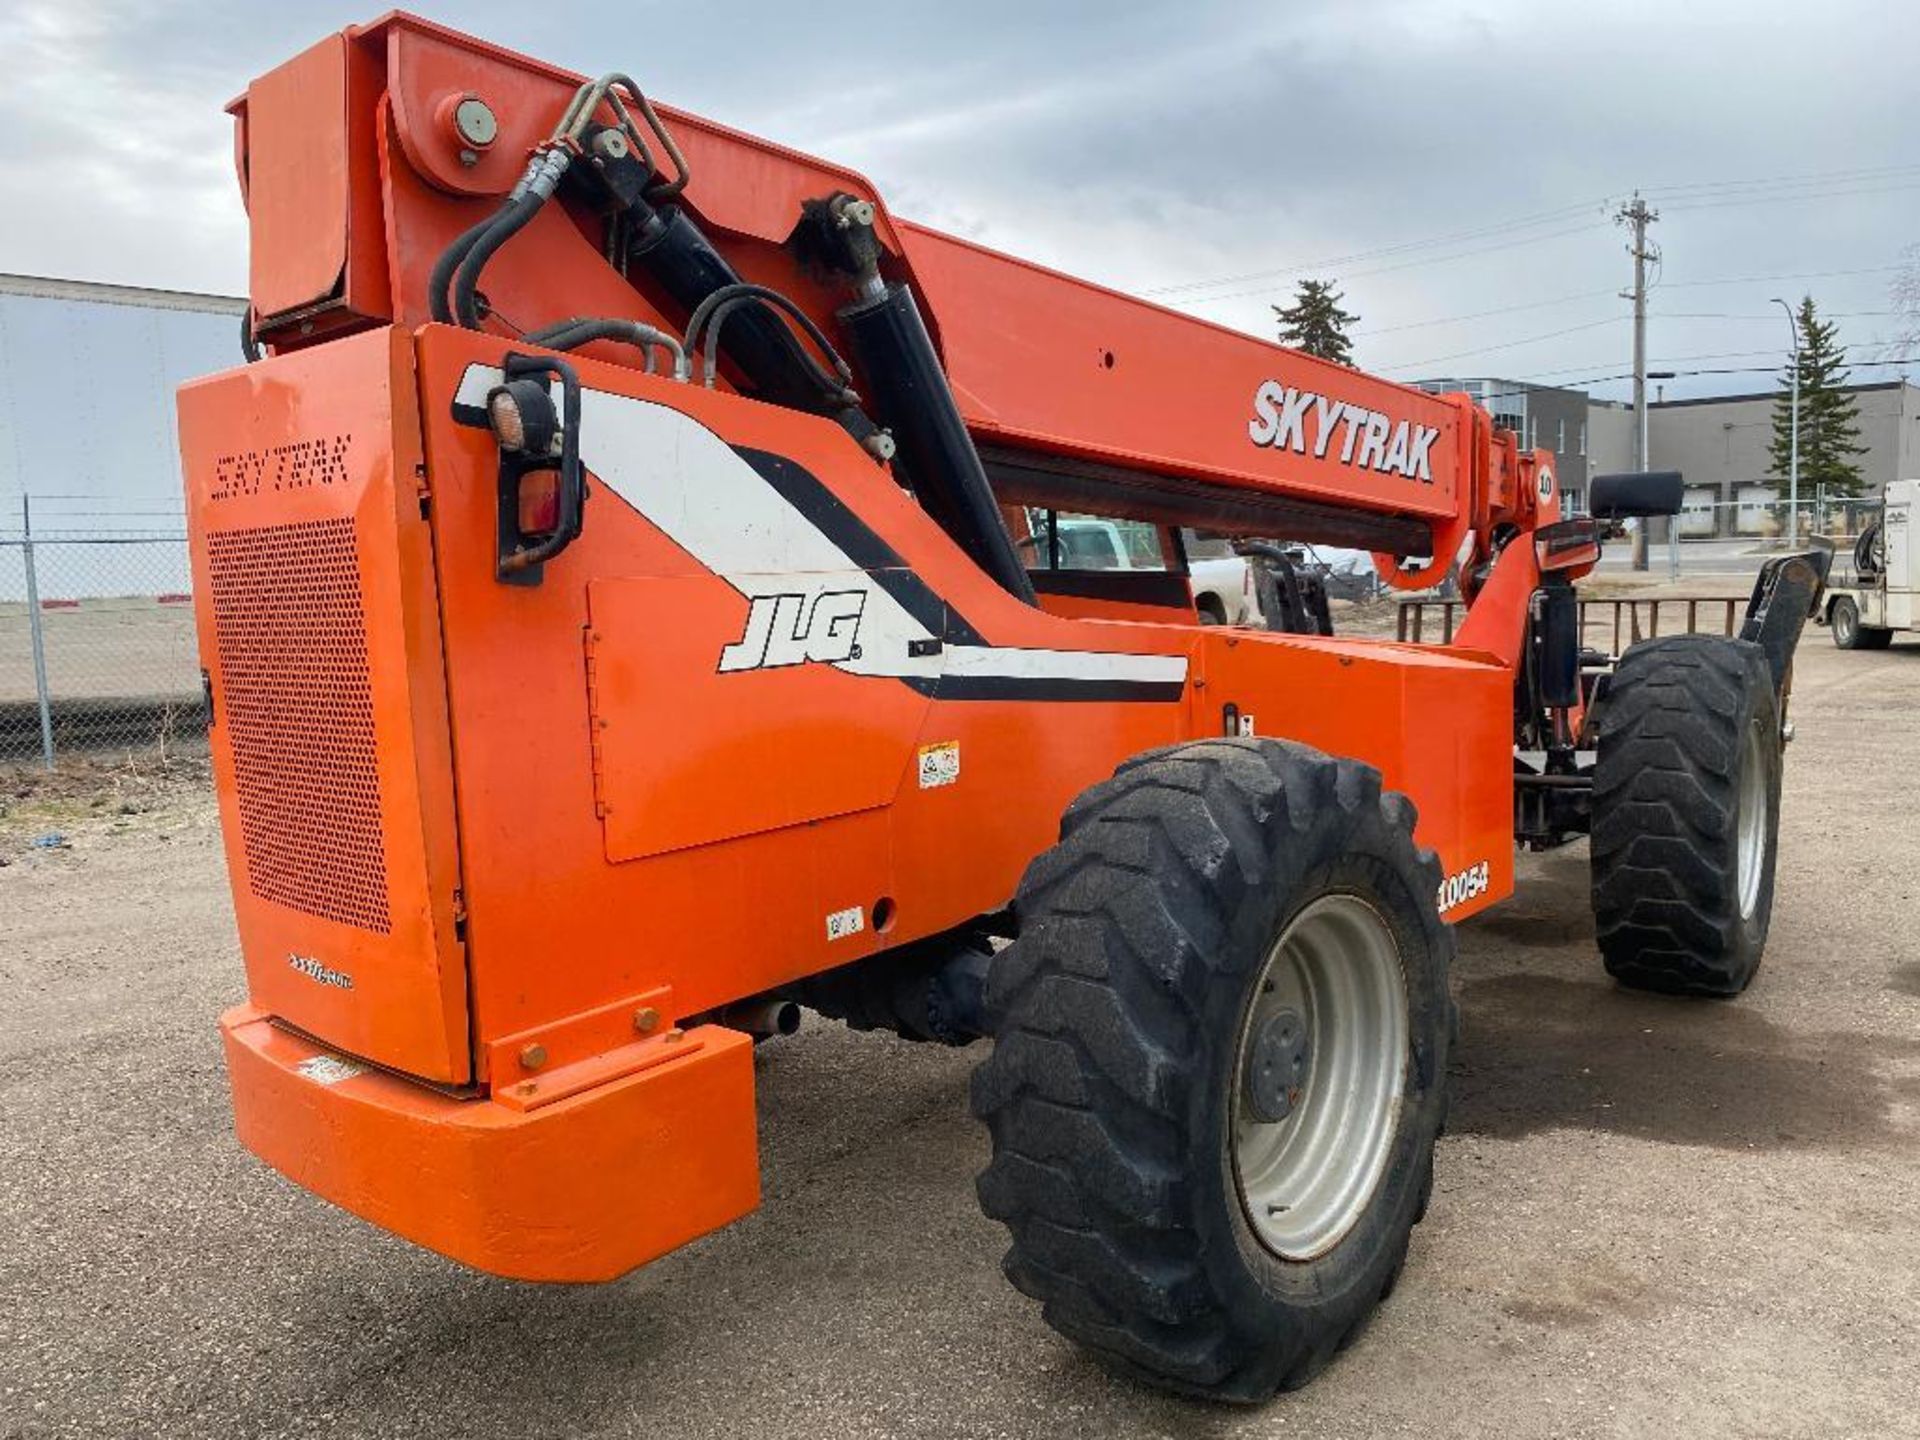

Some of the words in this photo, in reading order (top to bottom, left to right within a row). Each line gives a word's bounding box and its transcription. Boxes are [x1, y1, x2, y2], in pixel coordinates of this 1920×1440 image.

[211, 434, 351, 500] SKYTRAK
[1249, 379, 1440, 484] SKYTRAK
[716, 590, 868, 674] JLG
[1437, 859, 1489, 913] 10054
